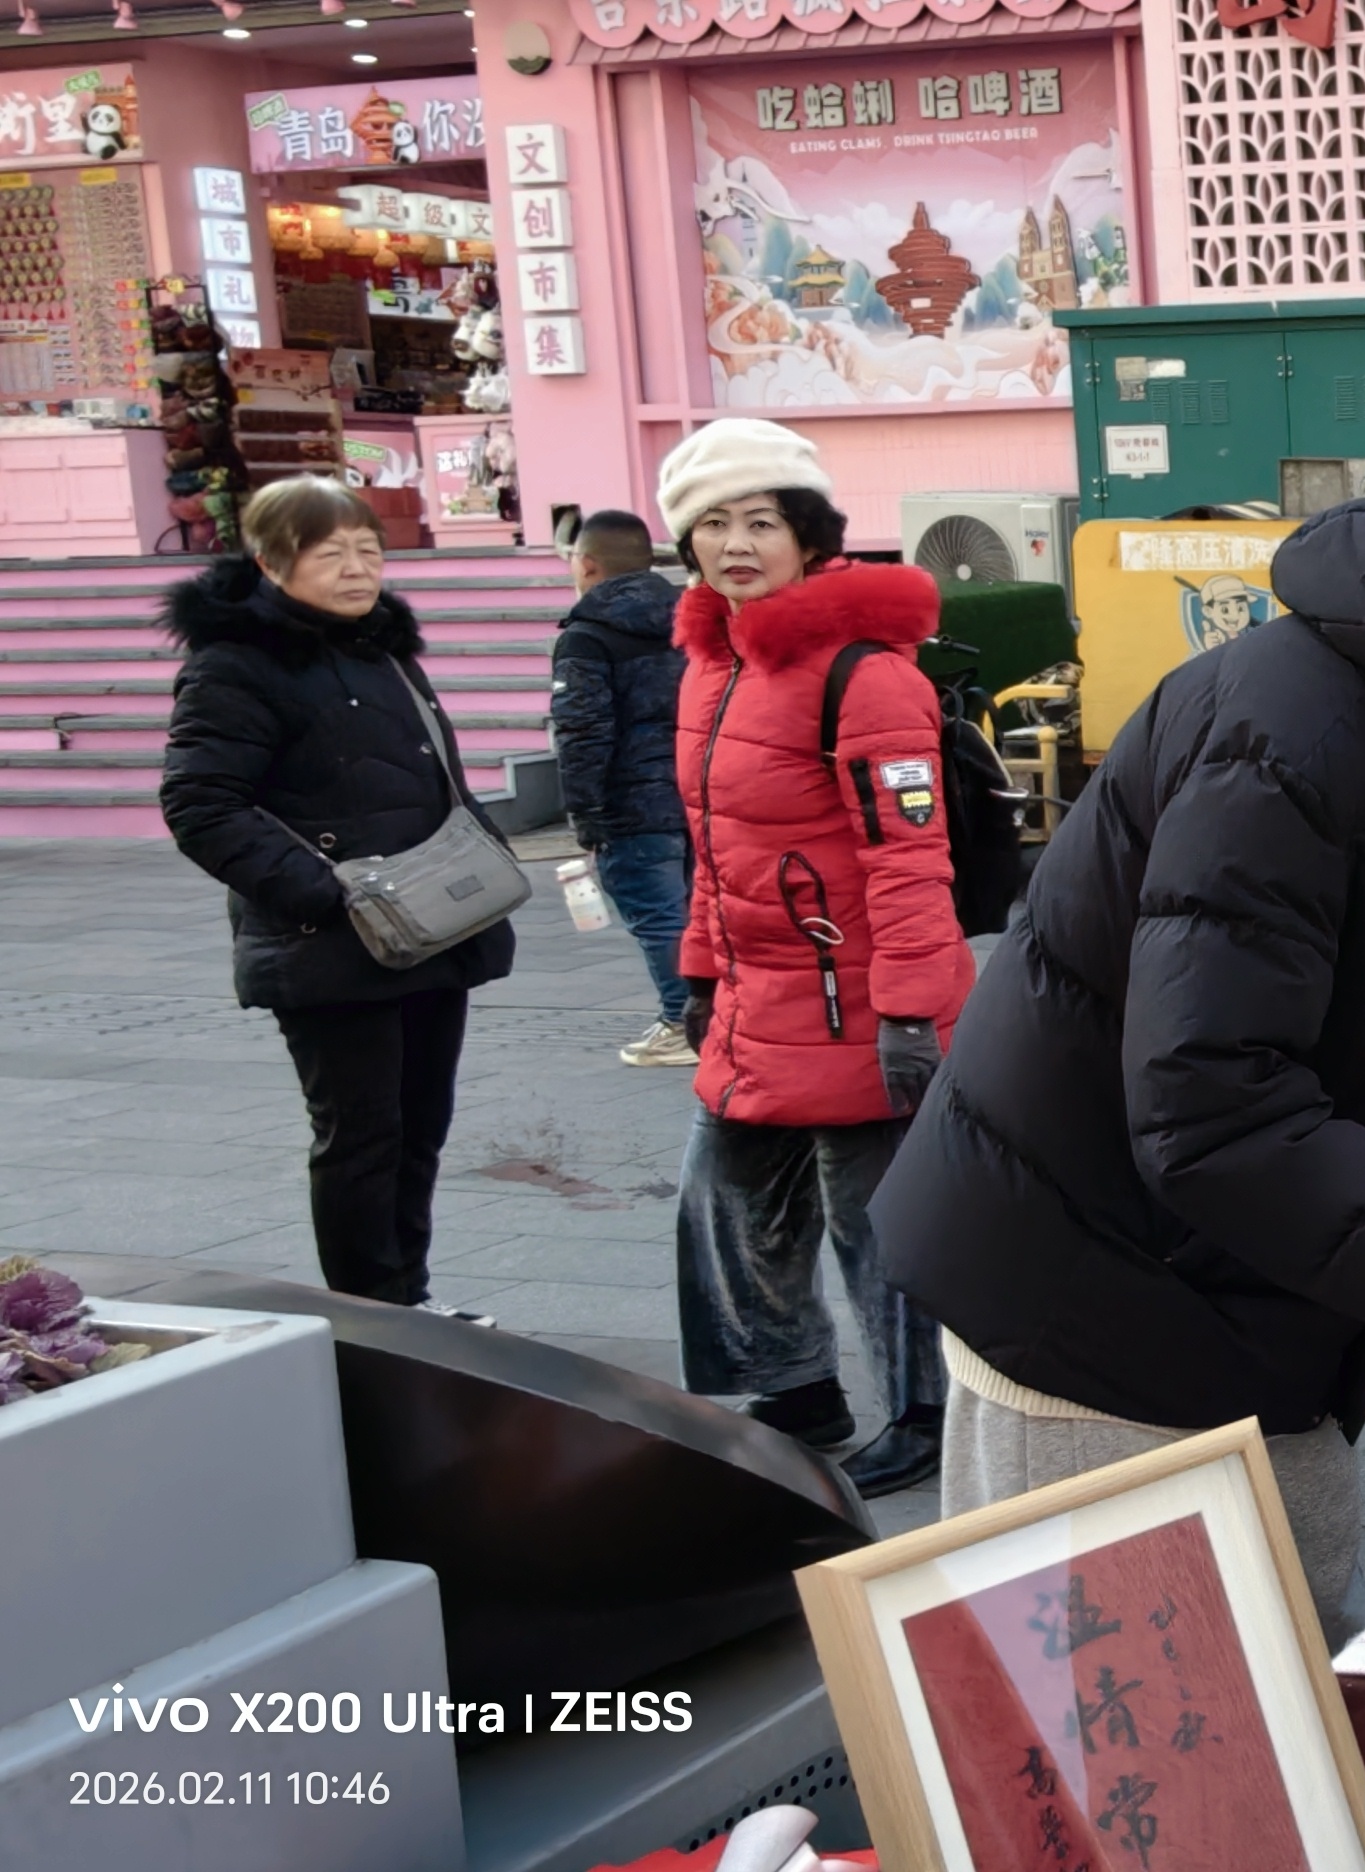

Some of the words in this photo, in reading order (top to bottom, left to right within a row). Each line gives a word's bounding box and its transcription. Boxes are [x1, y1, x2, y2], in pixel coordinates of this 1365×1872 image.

[756, 78, 895, 131] 吃蛤蜊
[916, 67, 1064, 120] 哈啤酒
[278, 107, 354, 161] 青岛
[789, 138, 837, 154] EATING
[893, 133, 934, 148] DRINK
[1003, 127, 1039, 142] BEER
[516, 134, 569, 369] 文创市集
[1122, 534, 1277, 569] 隆高压清洗
